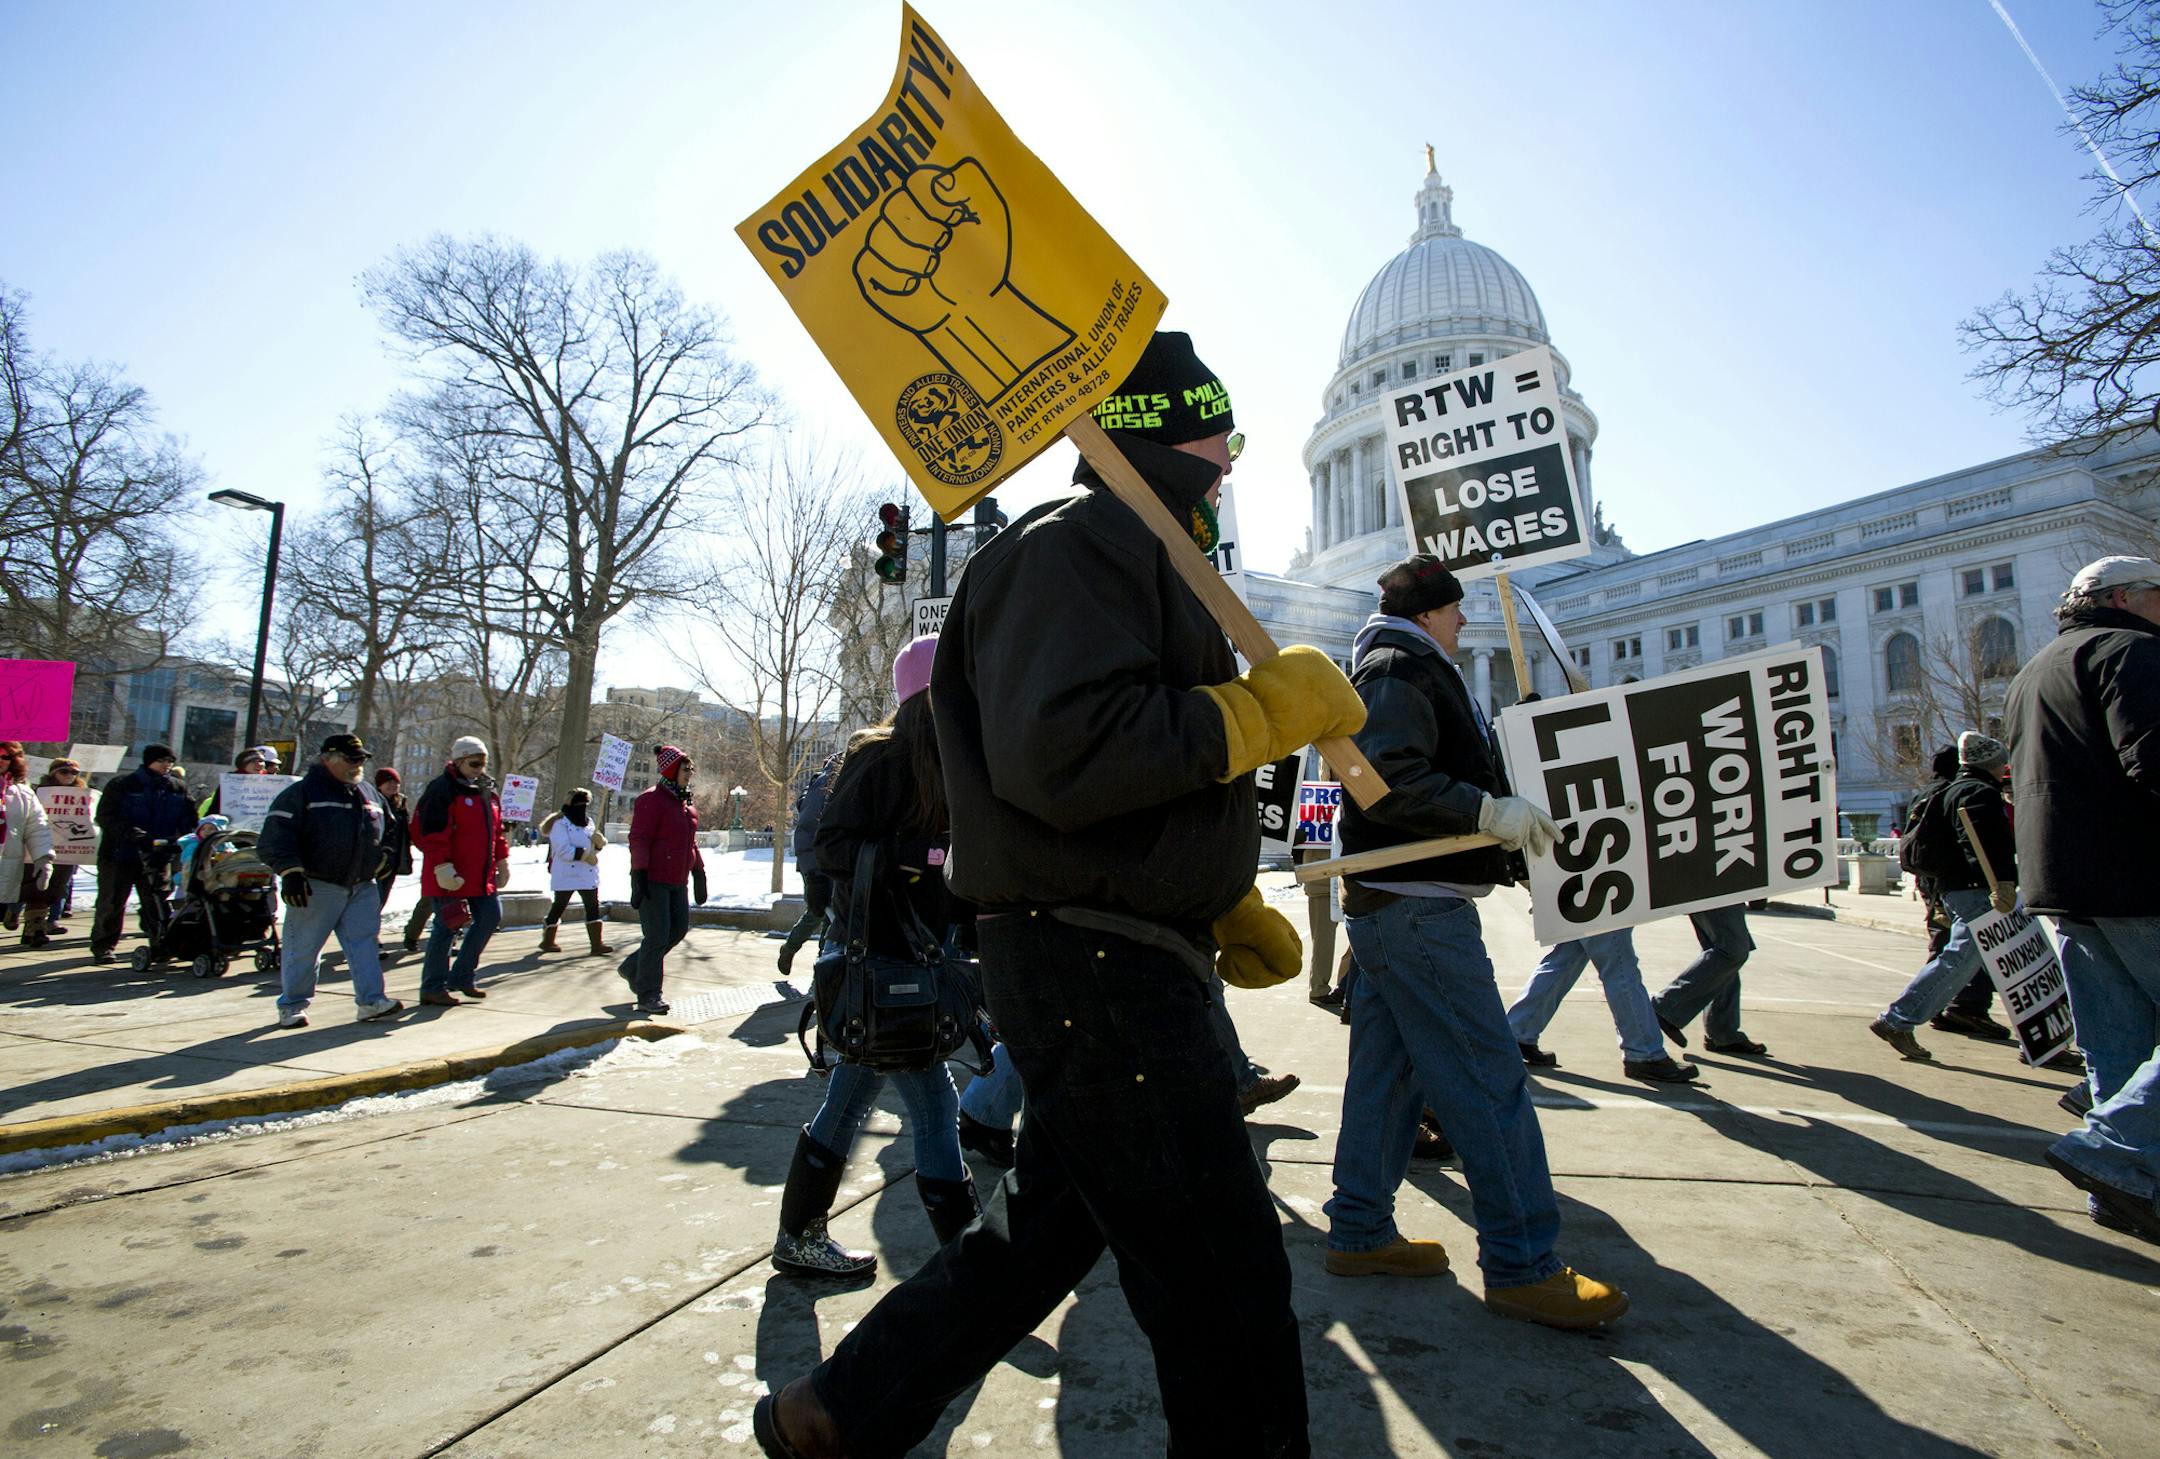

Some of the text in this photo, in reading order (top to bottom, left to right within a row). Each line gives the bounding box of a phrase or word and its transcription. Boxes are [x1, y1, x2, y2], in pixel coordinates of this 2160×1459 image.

[757, 18, 955, 279] SOLIDARITY!
[996, 279, 1125, 420] INTERNATIONAL UNION OF
[1006, 282, 1143, 433] PAINTERS & ALLIED TRADES
[897, 374, 977, 449] PAINTERS AND ALLIED TRADES
[1017, 369, 1110, 445] TEXT RTW to 48728
[1090, 393, 1170, 417] IGHTS
[1101, 412, 1162, 429] 1056
[1394, 370, 1541, 428] RTW =
[917, 406, 990, 463] ONE UNION
[930, 424, 1002, 484] INTERNATIONAL UNION
[1397, 406, 1555, 470] RIGHT TO
[1434, 465, 1540, 516] LOSE
[1423, 507, 1569, 562] WAGES
[918, 621, 943, 636] WA
[920, 604, 948, 619] ONE
[1300, 787, 1342, 804] PRO
[1700, 696, 1756, 877] WORK
[1766, 659, 1824, 880] RIGHT TO
[1299, 805, 1338, 822] UN
[1531, 702, 1635, 924] LESS
[1647, 741, 1699, 860] FOR
[1977, 904, 2037, 952] NDITIONS
[1996, 930, 2048, 978] WORKING
[2008, 963, 2064, 1015] UNSAFE
